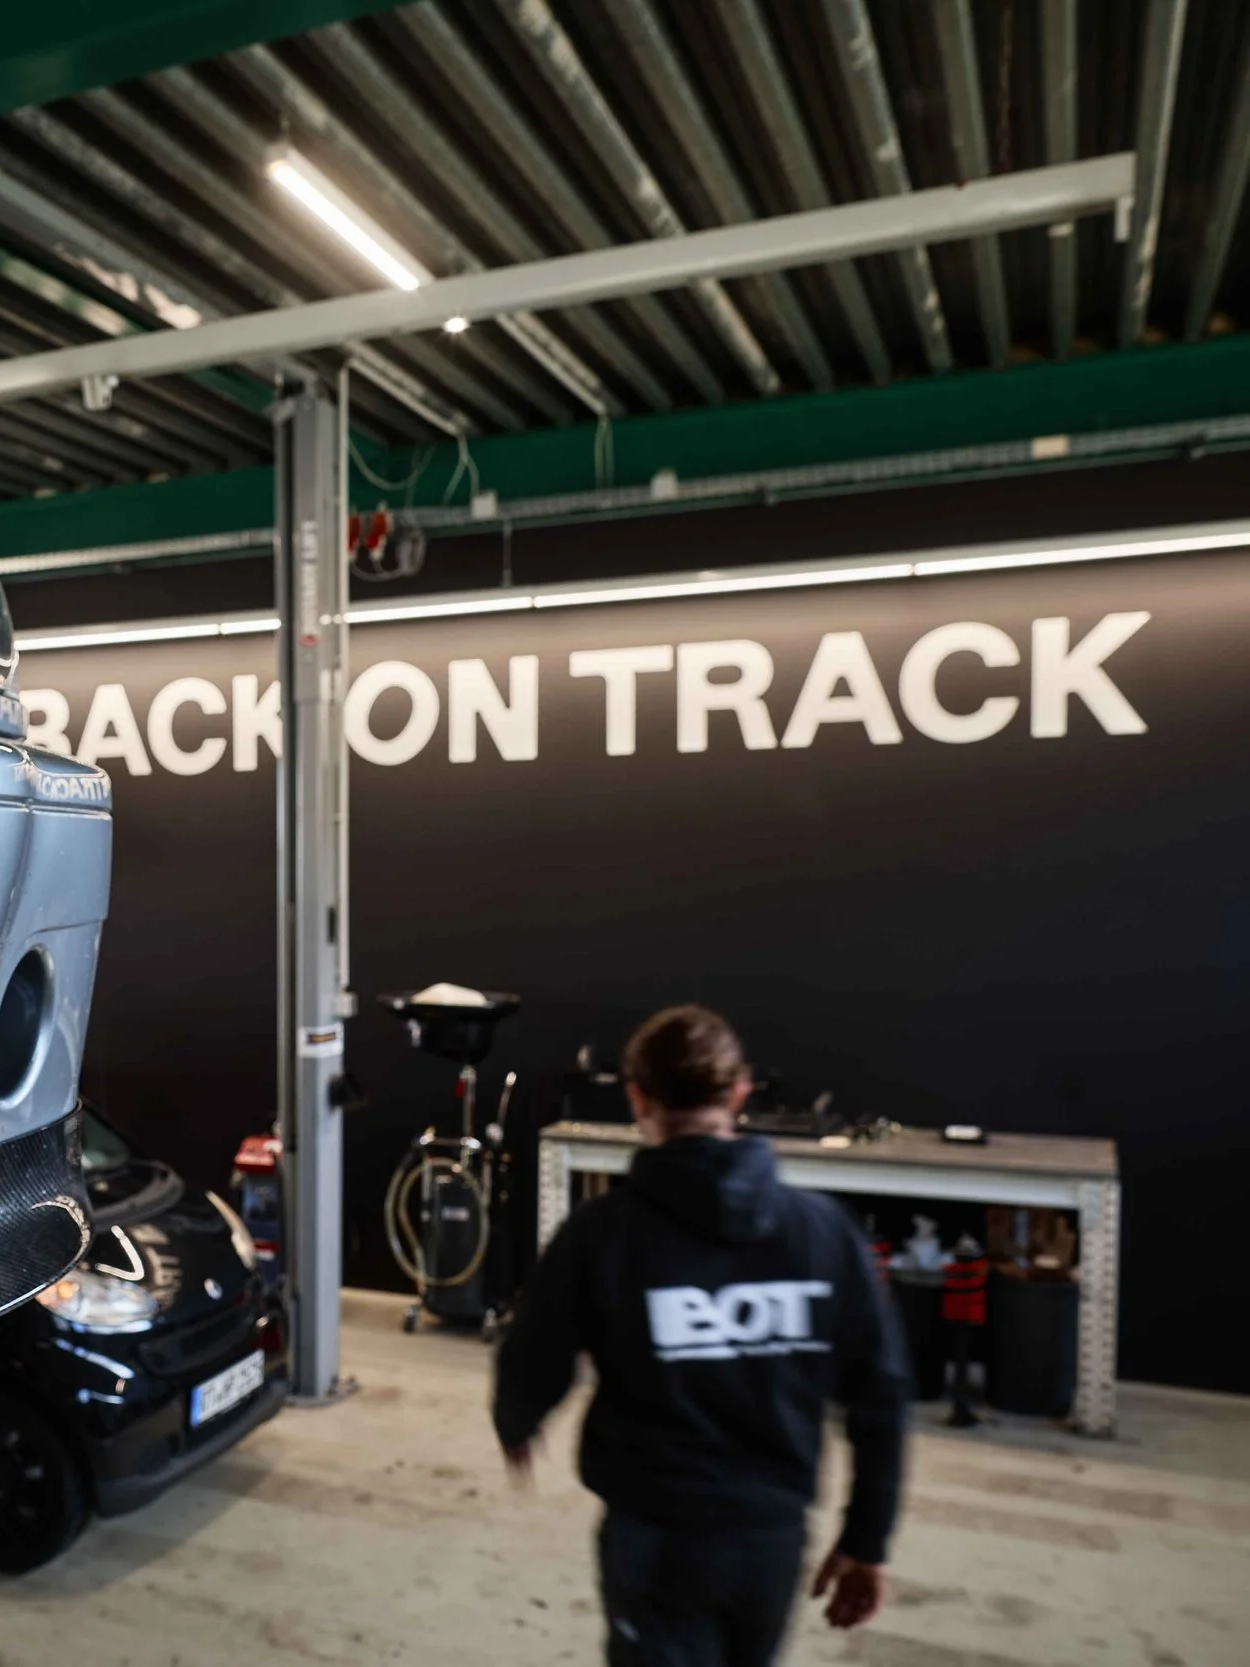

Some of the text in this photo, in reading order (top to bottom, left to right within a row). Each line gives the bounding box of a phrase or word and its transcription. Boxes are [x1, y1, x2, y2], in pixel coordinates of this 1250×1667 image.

[19, 611, 1152, 777] BACK ON TRACK
[644, 1280, 833, 1346] BOT
